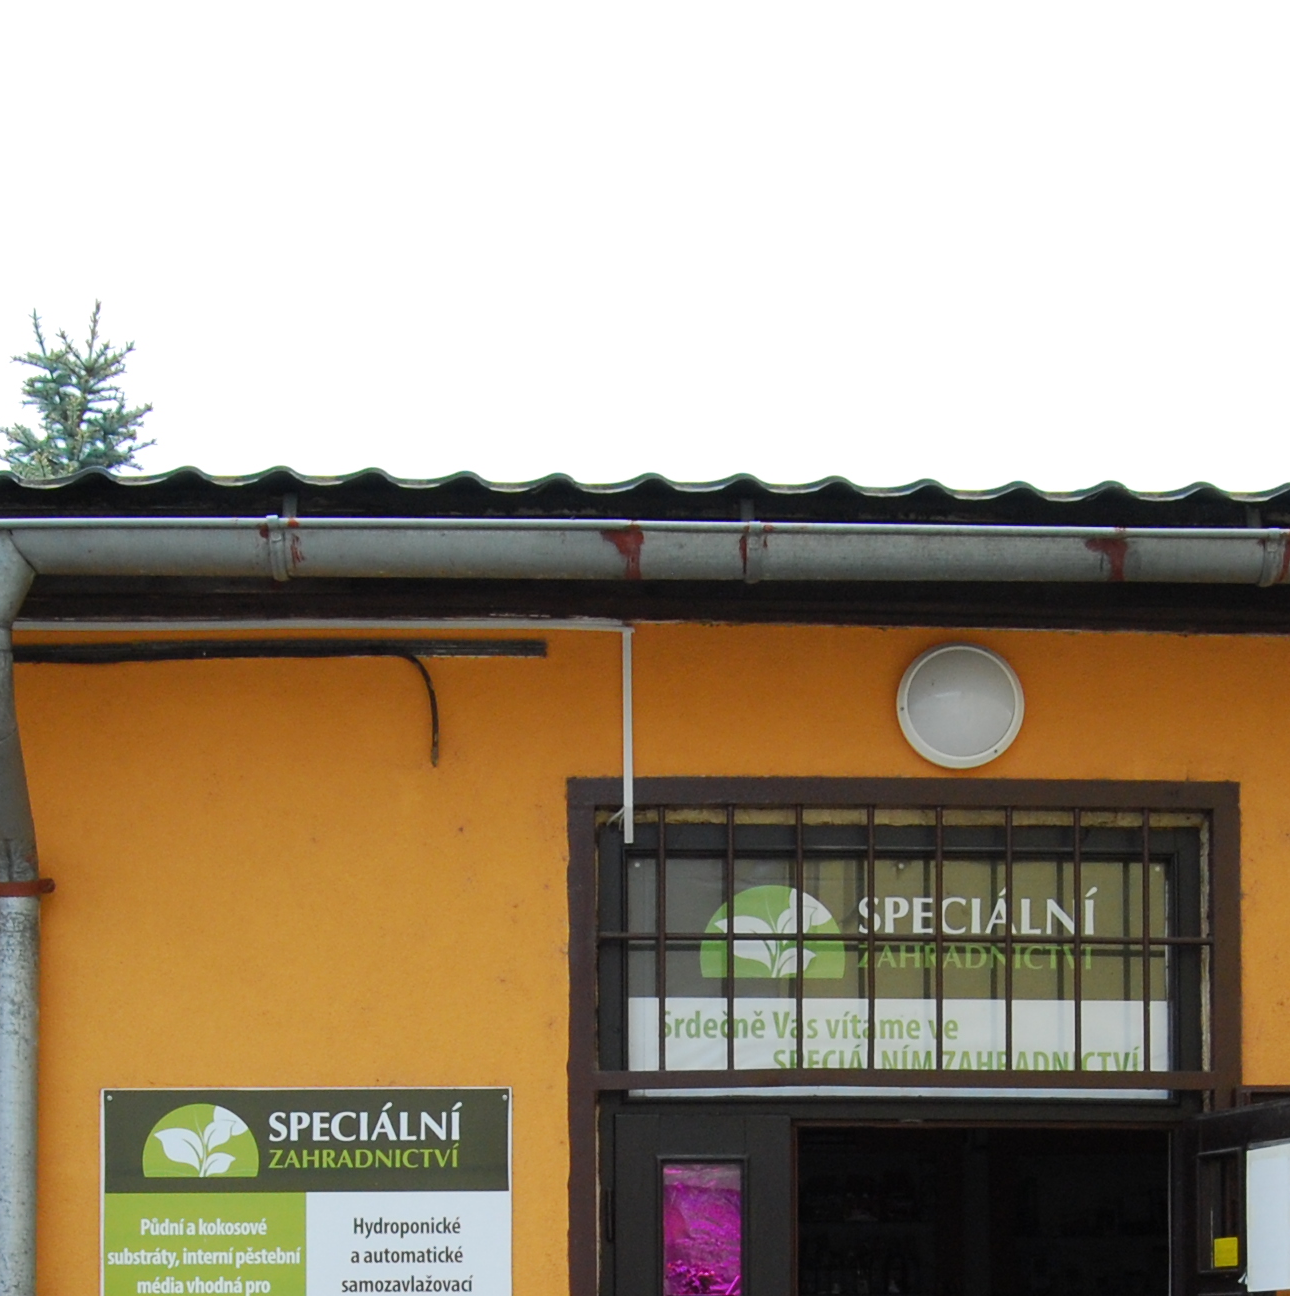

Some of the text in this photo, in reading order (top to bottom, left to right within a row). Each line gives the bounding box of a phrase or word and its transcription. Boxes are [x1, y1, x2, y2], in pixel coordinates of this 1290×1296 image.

[858, 886, 1098, 935] SPECIÁLNÍ
[773, 1045, 1141, 1071] SECIÁNÍM ZAHADNCTVÍ
[268, 1101, 463, 1142] SPECIÁLNÍ
[268, 1143, 459, 1169] ZAHRADNICTVÍ
[140, 1217, 268, 1236] Půdní a kokosové
[353, 1216, 461, 1239] Hydroponické
[107, 1246, 301, 1269] substráty, interní pěstební
[350, 1246, 463, 1263] a automatické
[137, 1276, 184, 1294] média
[186, 1276, 242, 1294] vhodná
[341, 1275, 473, 1293] samozavlažovací
